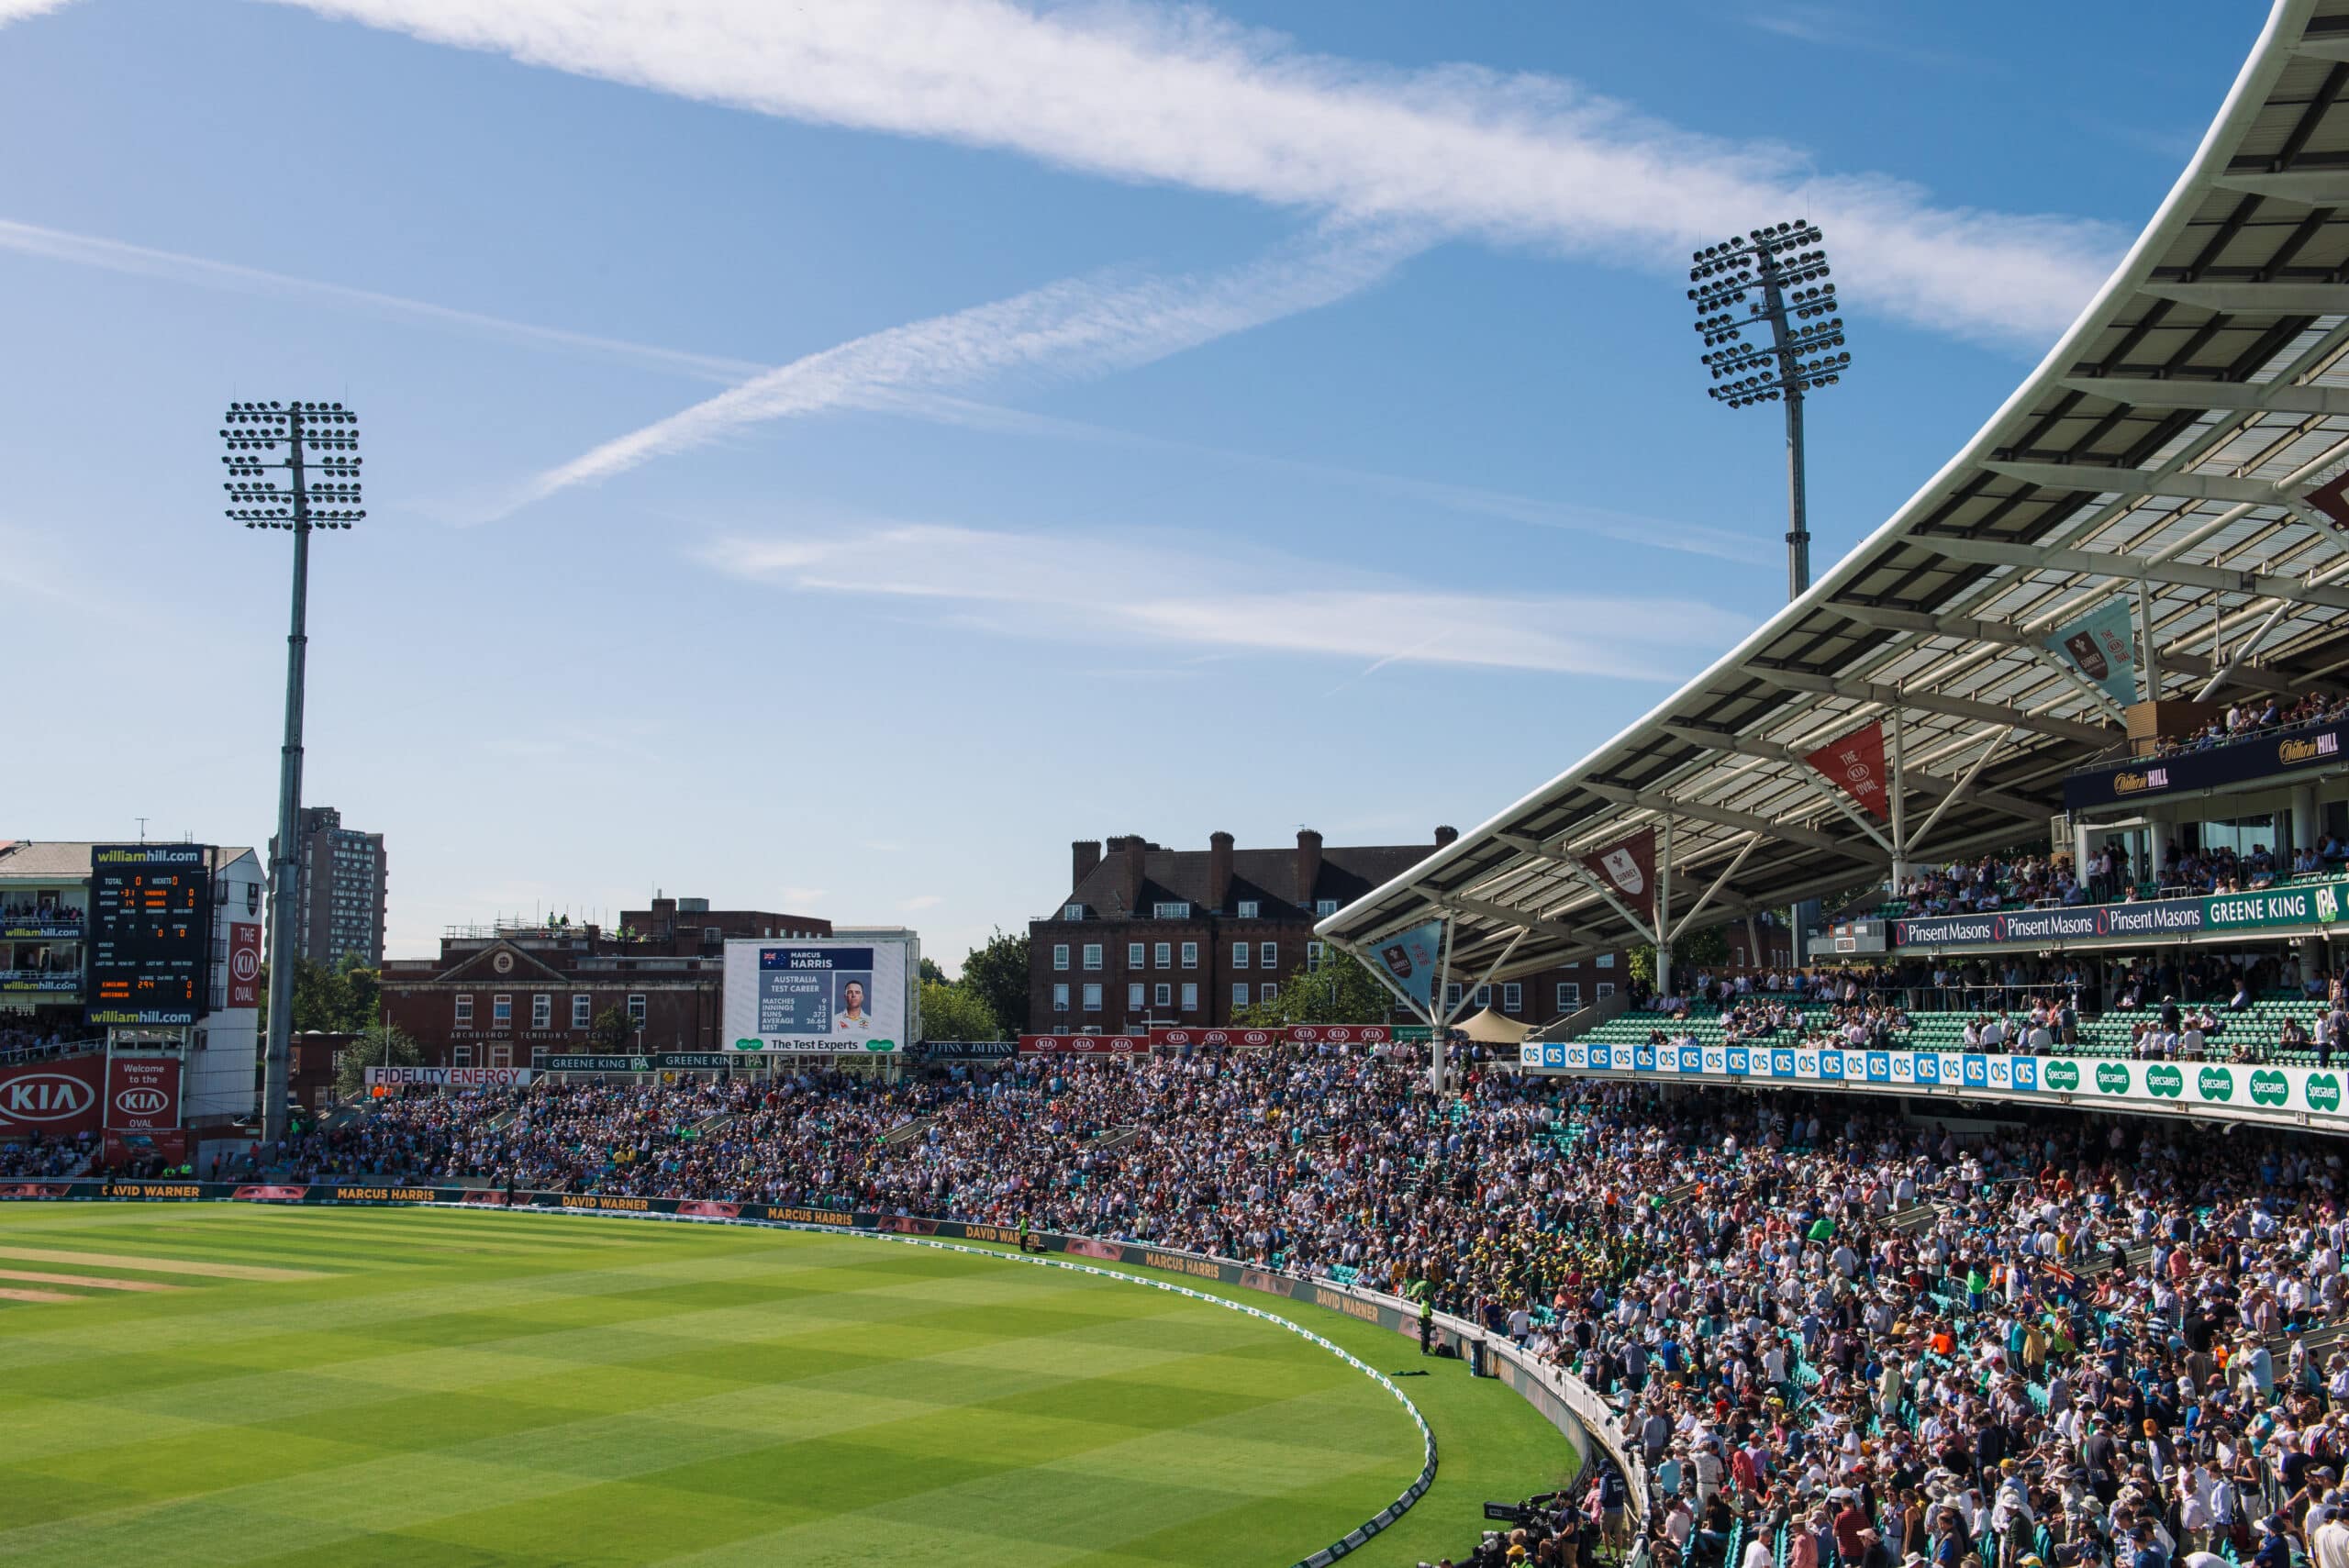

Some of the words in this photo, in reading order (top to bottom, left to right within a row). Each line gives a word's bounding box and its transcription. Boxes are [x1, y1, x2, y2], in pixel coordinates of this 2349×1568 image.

[2279, 738, 2316, 763] William
[2317, 732, 2338, 753] HILL
[1839, 749, 1859, 766] THE
[1850, 767, 1866, 778] KIA
[1856, 779, 1878, 795] OVAL
[2114, 773, 2147, 793] William
[2148, 768, 2168, 787] HILL
[98, 850, 197, 862] williamhill.com
[2210, 897, 2264, 923] GREENE
[2268, 895, 2306, 920] KING
[2315, 886, 2339, 918] IPA
[2009, 918, 2055, 937] Pinsent
[2058, 916, 2093, 934] Masons
[2110, 908, 2153, 931] Pinsent
[2154, 907, 2200, 928] Masons
[6, 928, 79, 937] williamhill.com
[240, 928, 255, 942] THE
[1909, 924, 1954, 942] Pinsent
[1956, 922, 1990, 940] Masons
[237, 955, 254, 973] KIA
[791, 960, 833, 969] HARRIS
[4, 981, 77, 990] williamhill.com
[235, 986, 253, 1001] OVAL
[91, 1011, 191, 1023] williamhill.com
[772, 1040, 791, 1049] The
[793, 1040, 815, 1049] Test
[818, 1040, 858, 1051] Experts
[970, 1044, 985, 1052] JM
[988, 1043, 1012, 1052] FINN
[552, 1059, 596, 1069] GREENE
[598, 1059, 626, 1069] KING
[631, 1058, 649, 1070] IPA
[666, 1056, 707, 1065] GREENE
[712, 1056, 740, 1065] KING
[745, 1055, 763, 1066] IPA
[124, 1064, 164, 1073] Welcome
[2047, 1068, 2076, 1082] Specsavers
[142, 1075, 158, 1084] the
[374, 1069, 448, 1083] FIDELITY
[451, 1069, 520, 1084] ENERGY
[2098, 1072, 2127, 1084] Specsavers
[2149, 1073, 2179, 1088] Specsavers
[2201, 1076, 2230, 1091] Specsavers
[2253, 1079, 2286, 1095] Specsavers
[2308, 1082, 2337, 1100] Specsavers
[11, 1084, 77, 1109] KIA
[125, 1094, 160, 1108] KIA
[129, 1118, 152, 1128] OVAL
[143, 1186, 200, 1196] WARNER
[338, 1188, 388, 1199] MARCUS
[392, 1189, 435, 1201] HARRIS
[562, 1195, 596, 1207] DAVID
[600, 1197, 648, 1210] WARNER
[768, 1207, 812, 1222] MARCUS
[815, 1211, 852, 1226] HARRIS
[966, 1225, 996, 1240] DAVID
[999, 1229, 1041, 1246] WARER
[1146, 1252, 1184, 1272] MARCUS
[1186, 1259, 1219, 1279] HARRIS
[1317, 1288, 1340, 1309] DAVID
[1342, 1297, 1378, 1322] WARNER
